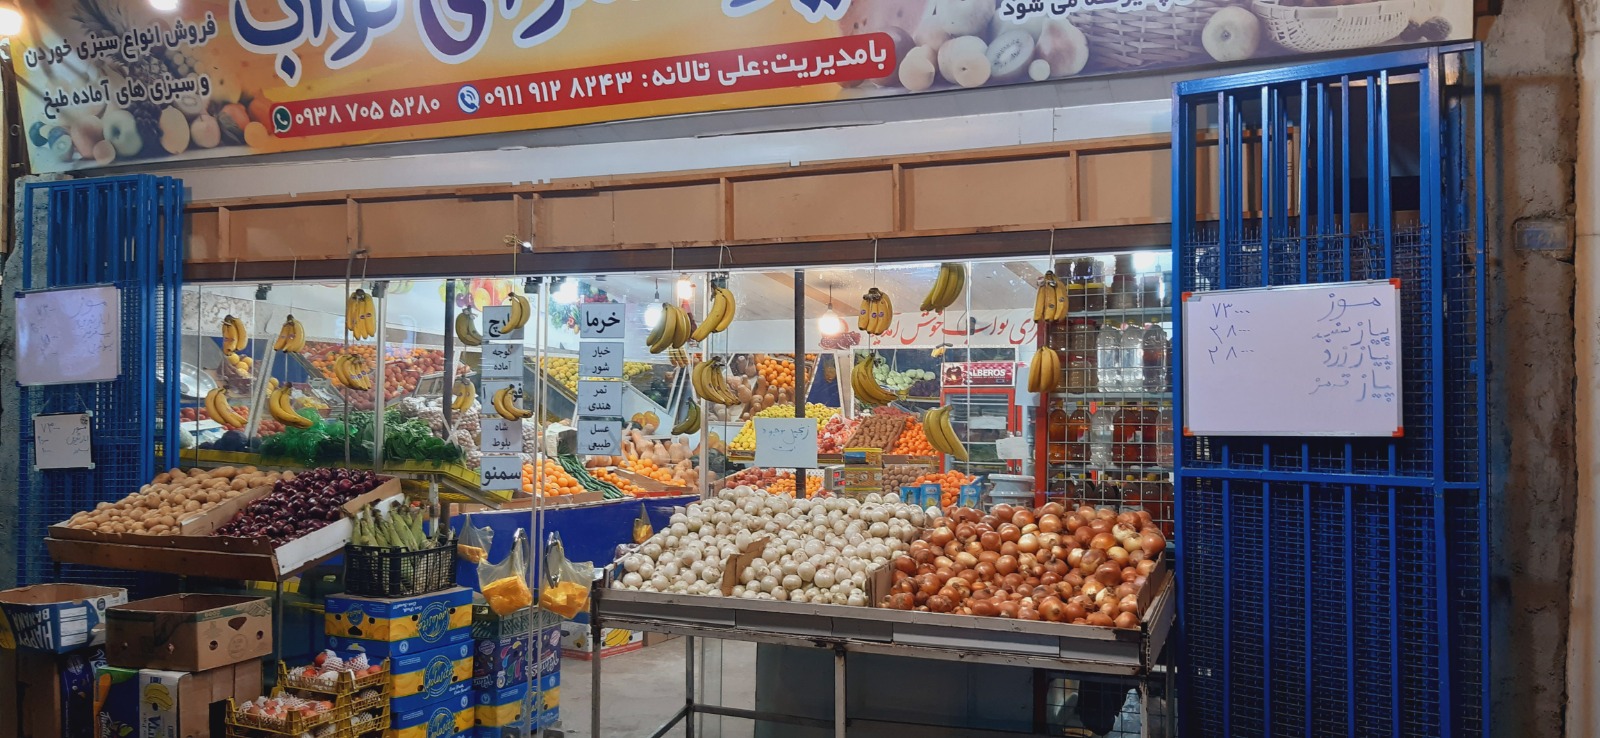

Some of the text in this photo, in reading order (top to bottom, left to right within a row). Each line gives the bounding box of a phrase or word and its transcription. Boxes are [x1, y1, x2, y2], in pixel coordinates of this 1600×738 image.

[25, 14, 216, 68] فروش انواع سبزی خوردن
[43, 75, 210, 119] و سبزی های آماده طبخ
[484, 84, 522, 106] ۰۹۱۱
[528, 80, 561, 103] ۹۱۲
[570, 71, 633, 99] ۸۲۴۳
[295, 95, 440, 126] ۰۹۳۸ ۷۰۵ ۵۲۸۰
[1316, 292, 1383, 322] موز
[586, 310, 621, 333] خرما
[1350, 319, 1391, 346] پیاز
[592, 348, 611, 358] خیار
[1350, 345, 1393, 370] پیاز
[494, 361, 511, 371] آماده
[592, 364, 610, 375] شور
[593, 387, 608, 397] تمر
[1356, 369, 1395, 402] پیاز
[588, 402, 611, 412] هندی
[494, 422, 509, 432] شاه
[590, 424, 610, 435] عسل
[492, 437, 511, 448] بلوط
[588, 440, 611, 451] طبیعی
[482, 464, 522, 486] سمنو
[18, 621, 54, 650] HAPPY
